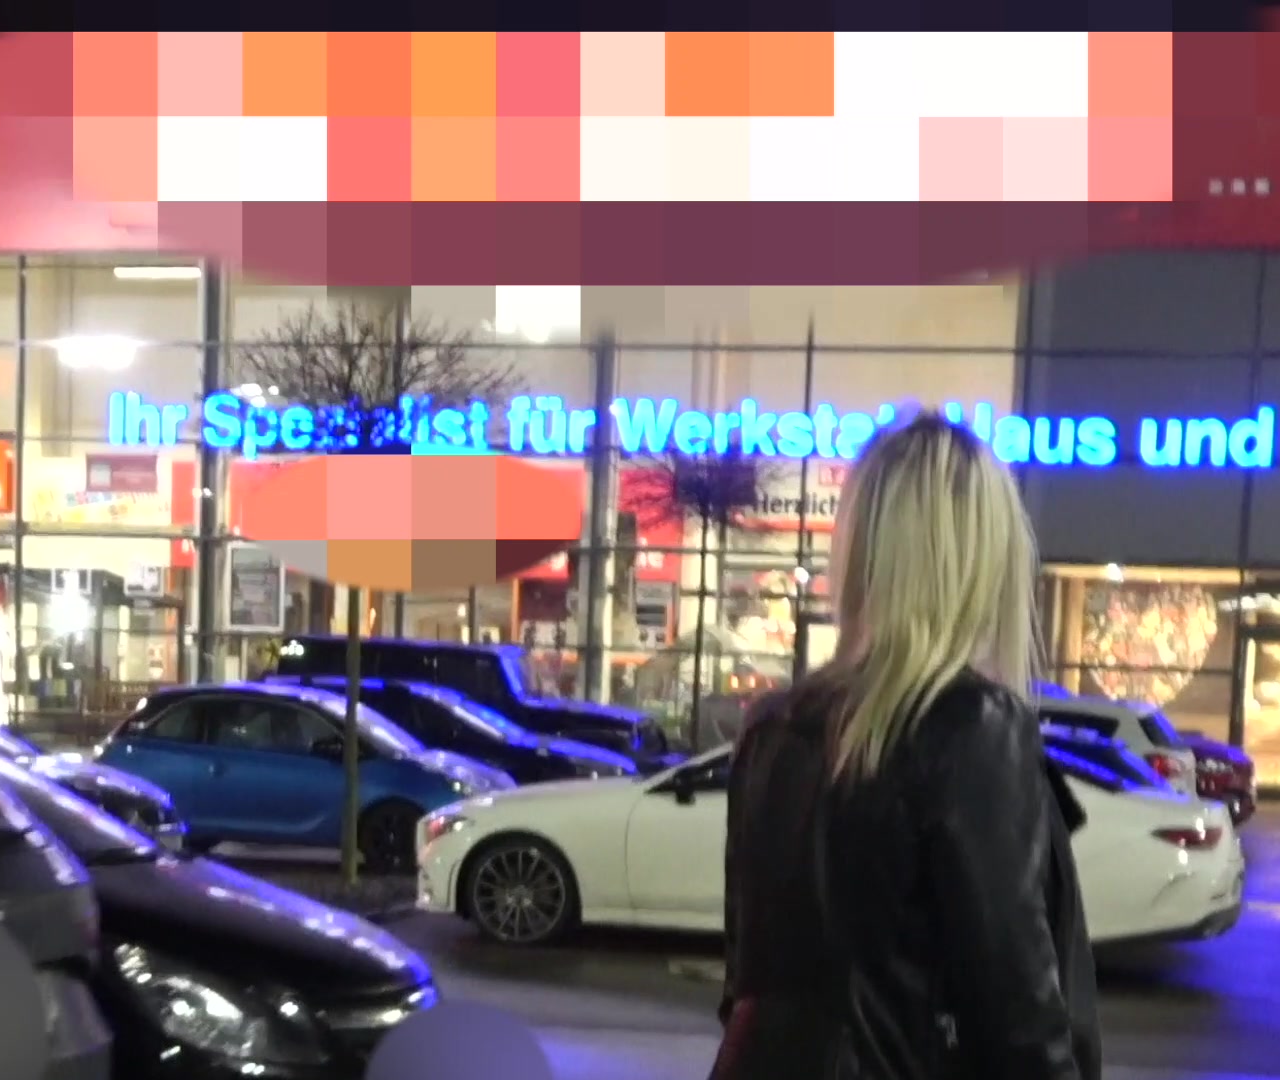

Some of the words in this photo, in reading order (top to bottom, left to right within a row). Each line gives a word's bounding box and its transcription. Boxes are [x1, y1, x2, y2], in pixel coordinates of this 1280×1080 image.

[108, 391, 188, 447] Ihr
[510, 395, 596, 454] für
[613, 398, 900, 459] Werksta
[1140, 405, 1275, 469] und
